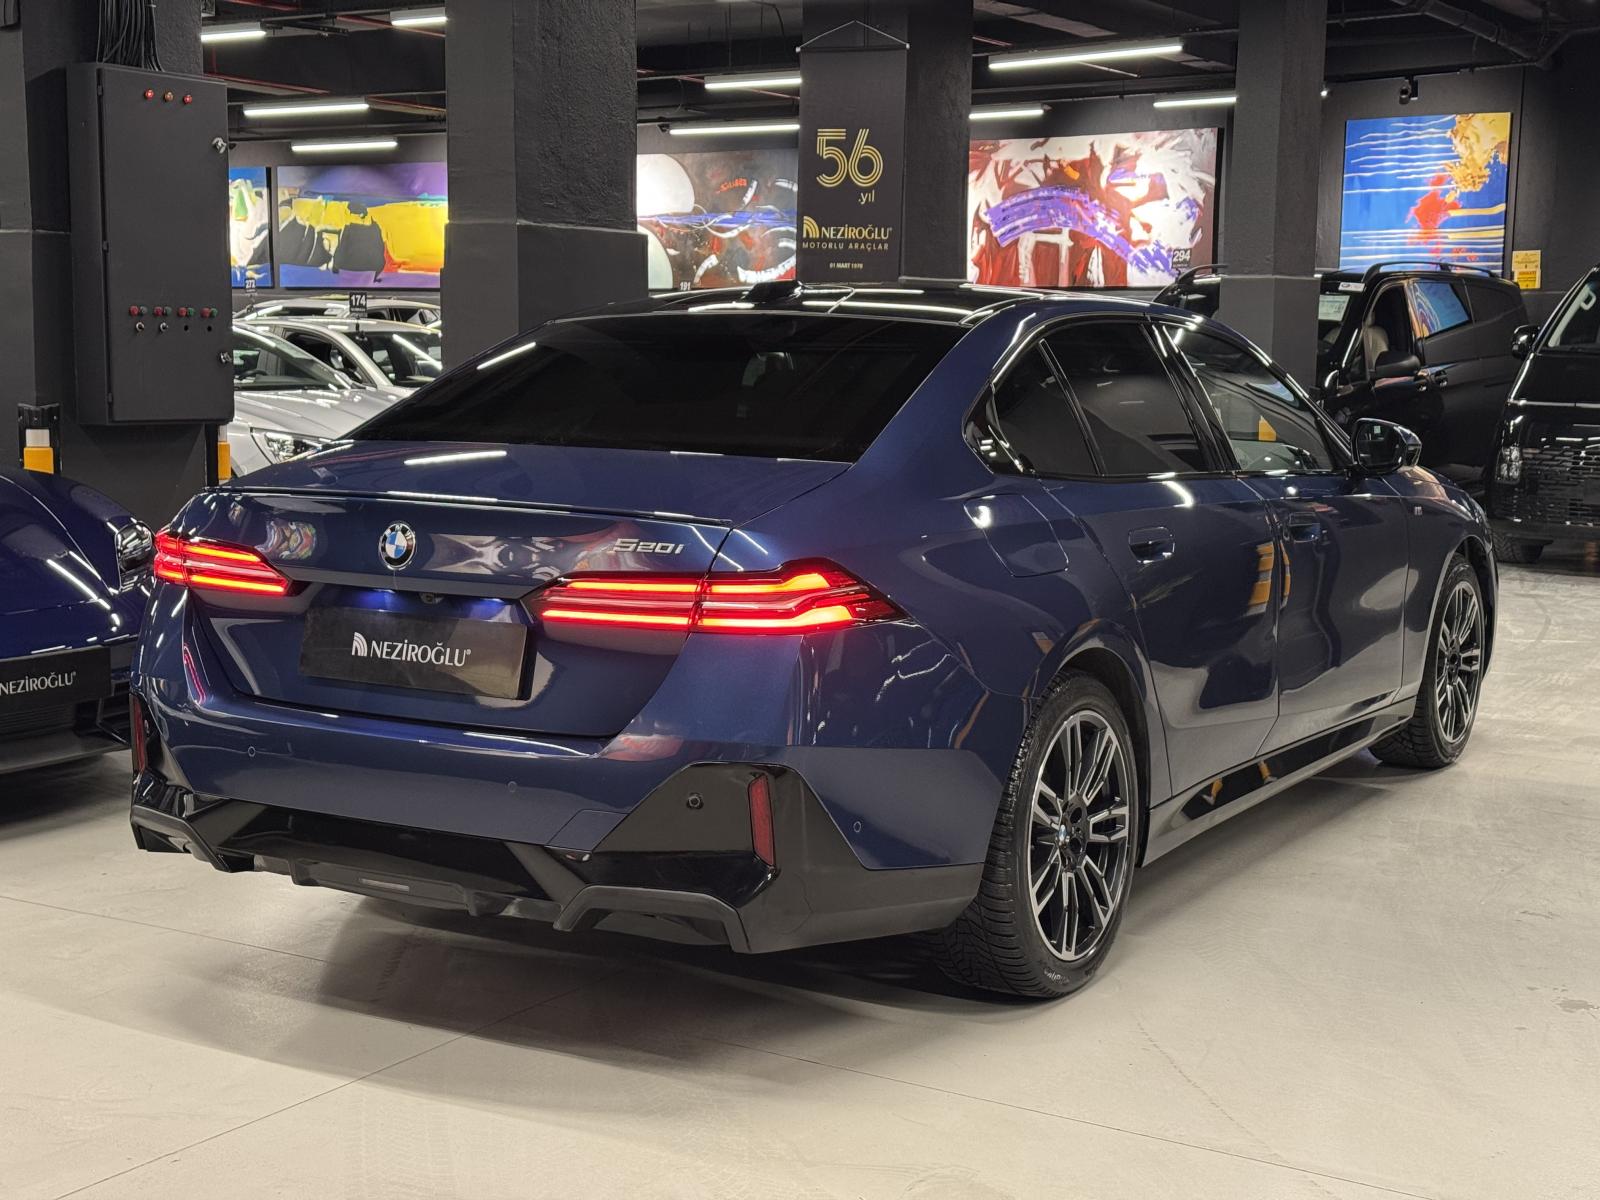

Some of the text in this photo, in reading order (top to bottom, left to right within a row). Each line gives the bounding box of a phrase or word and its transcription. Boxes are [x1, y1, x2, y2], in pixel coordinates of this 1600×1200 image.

[816, 128, 884, 187] 56
[802, 241, 889, 252] MOTORLU ARAÇLAR
[1173, 250, 1191, 262] 294
[680, 281, 691, 291] 191
[351, 294, 367, 307] 174
[613, 538, 685, 554] 520i
